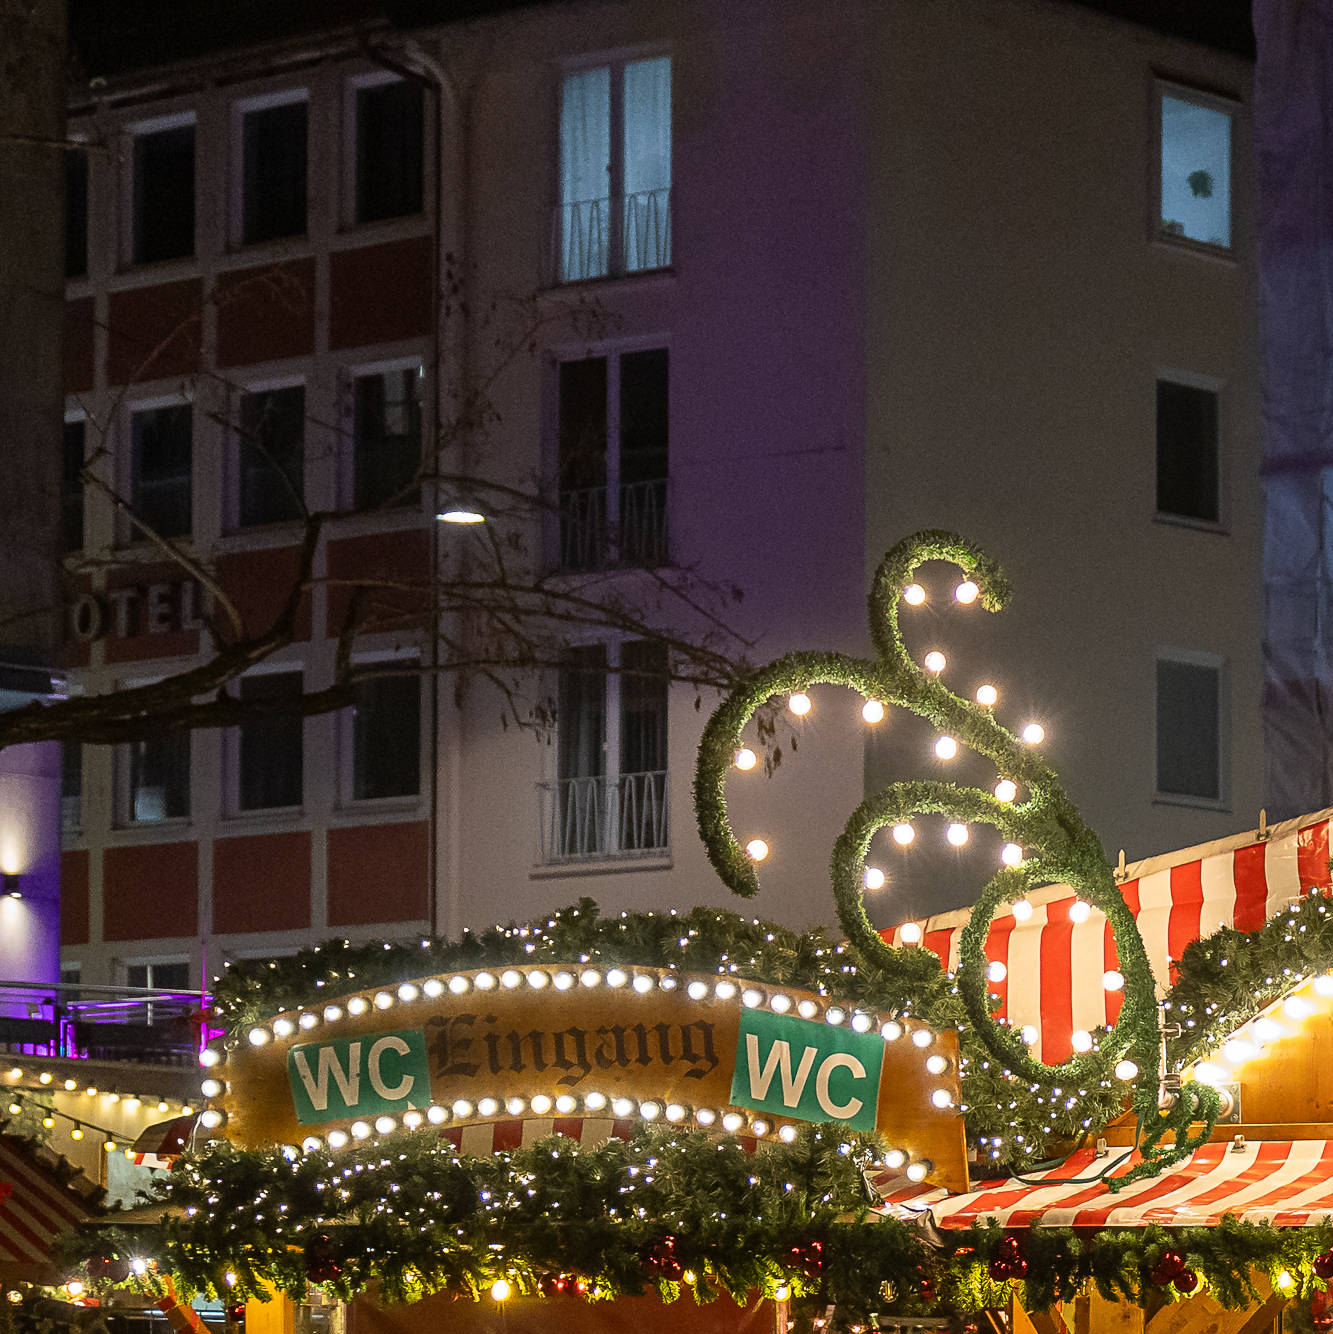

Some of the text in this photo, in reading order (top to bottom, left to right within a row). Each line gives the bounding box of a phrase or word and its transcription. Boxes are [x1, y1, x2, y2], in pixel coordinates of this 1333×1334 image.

[74, 580, 207, 641] OTEL
[293, 1012, 867, 1120] WC Eingang WC
